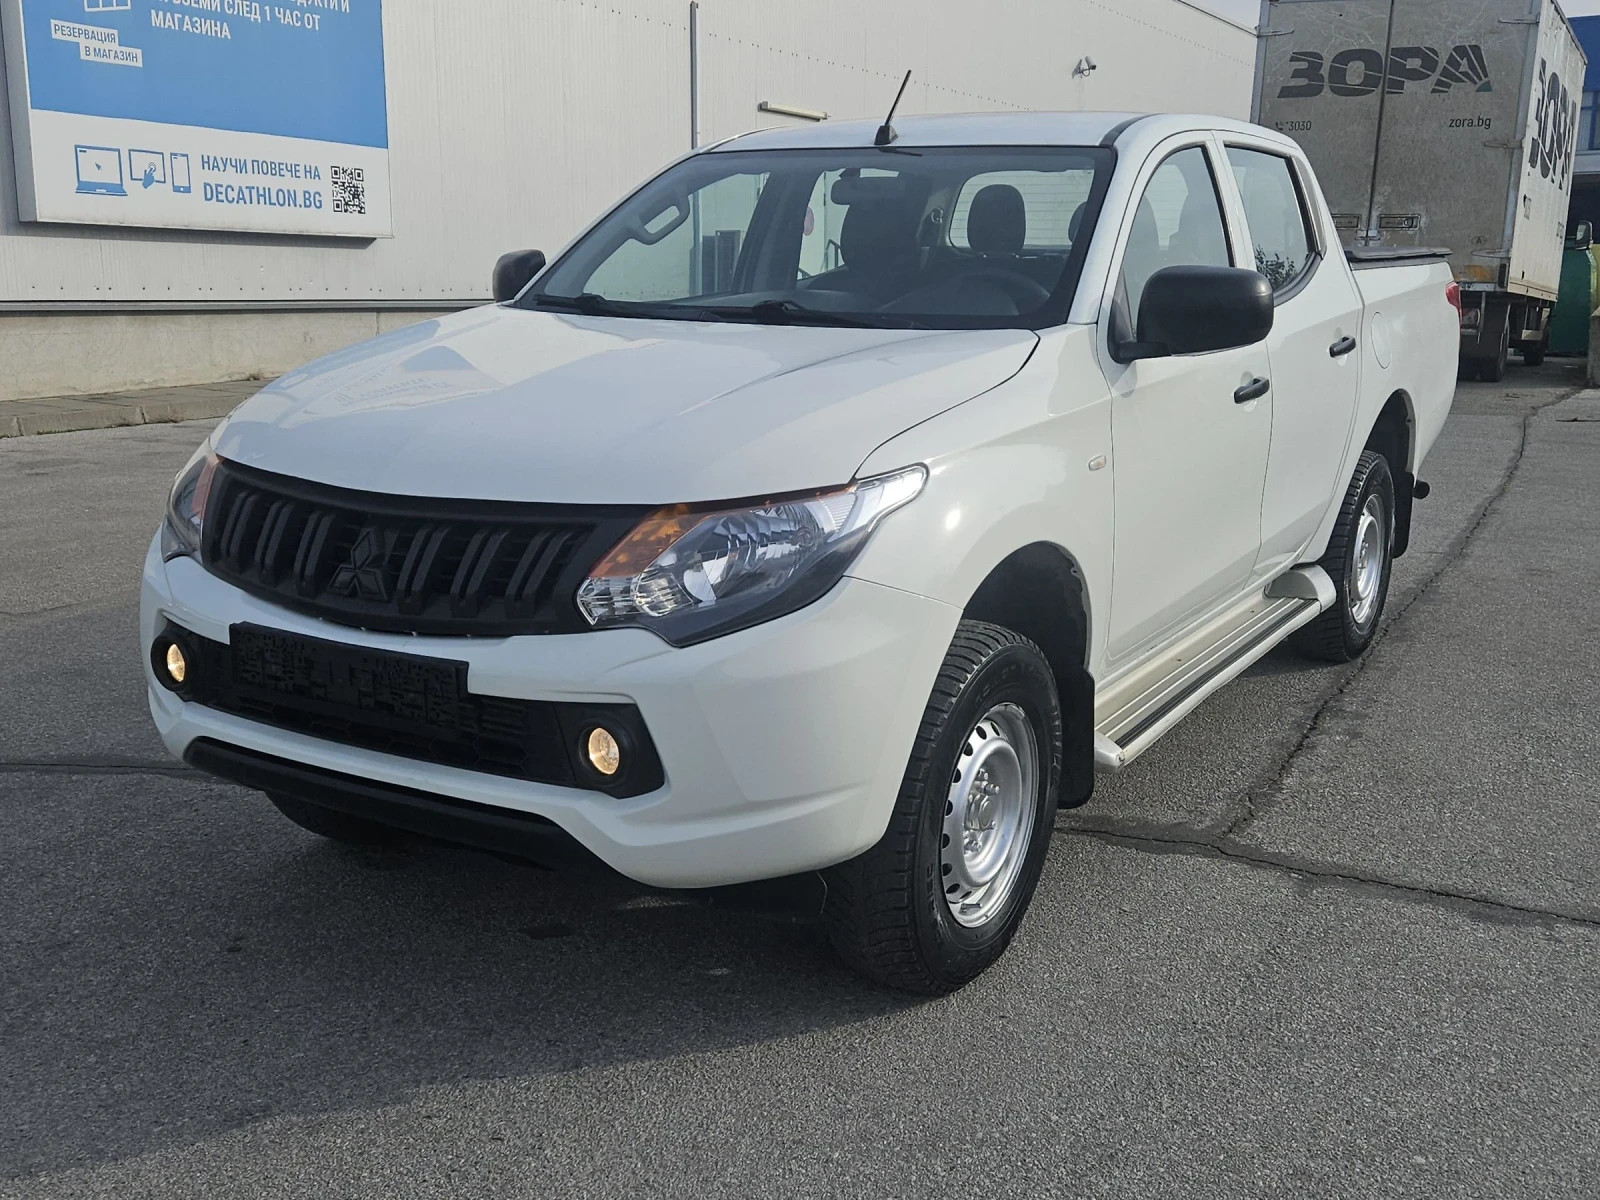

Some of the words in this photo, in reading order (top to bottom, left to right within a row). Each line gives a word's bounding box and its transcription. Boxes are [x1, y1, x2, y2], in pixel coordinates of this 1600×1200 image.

[150, 9, 231, 39] МАГАЗИНА
[174, 0, 221, 12] ЕМИ
[224, 0, 262, 23] СЛЕД
[264, 6, 271, 21] 1
[275, 7, 301, 27] ЧАС
[304, 13, 321, 31] ОТ
[53, 24, 117, 44] РЕЗЕРВАЦИЯ
[85, 46, 91, 57] В
[94, 47, 138, 63] МАГАЗИН
[1277, 44, 1493, 98] ЗОРА
[1449, 116, 1492, 130] zora.bg
[201, 154, 248, 174] НАУЧИ
[251, 159, 301, 178] ПОВЕЧЕ
[304, 164, 321, 180] НА
[203, 182, 323, 209] DECATHLON.BG
